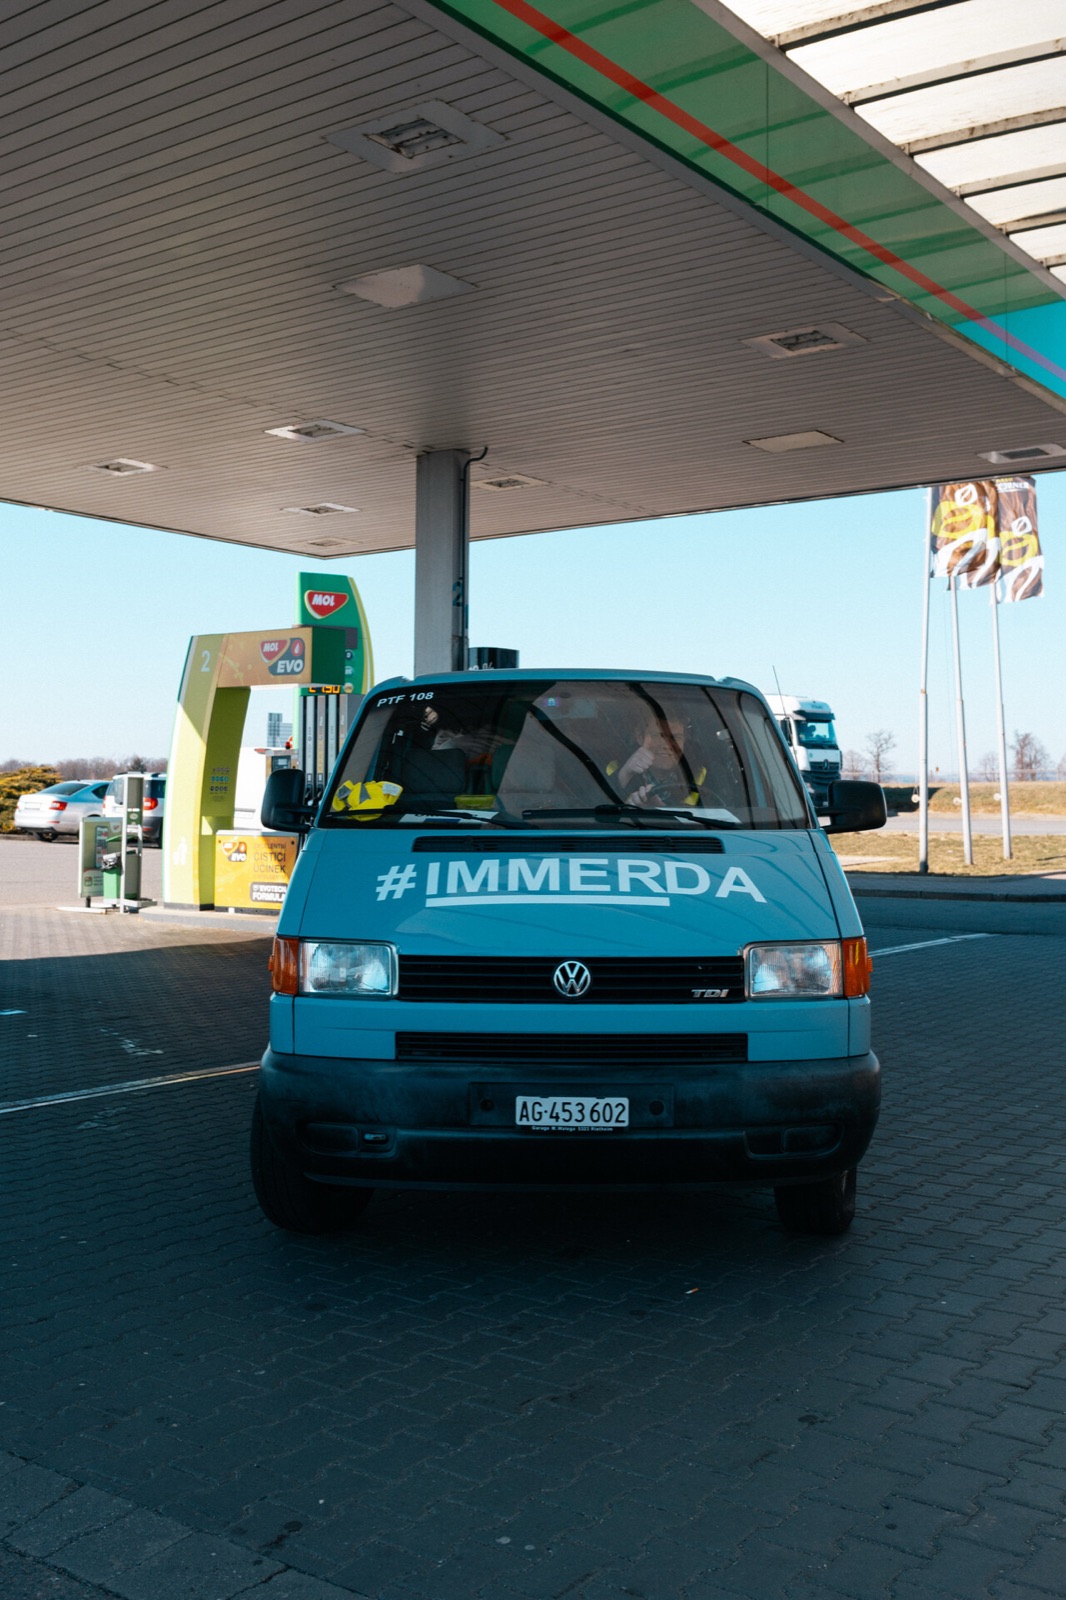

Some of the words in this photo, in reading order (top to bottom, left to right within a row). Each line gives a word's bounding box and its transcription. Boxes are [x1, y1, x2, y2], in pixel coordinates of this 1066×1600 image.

[312, 594, 334, 606] MOL
[263, 642, 279, 652] MOL
[201, 651, 210, 672] 2
[277, 659, 303, 673] EVO
[377, 695, 406, 707] PTF
[409, 691, 435, 702] 108
[376, 858, 768, 904] #IMMERDA
[691, 989, 729, 998] TDI
